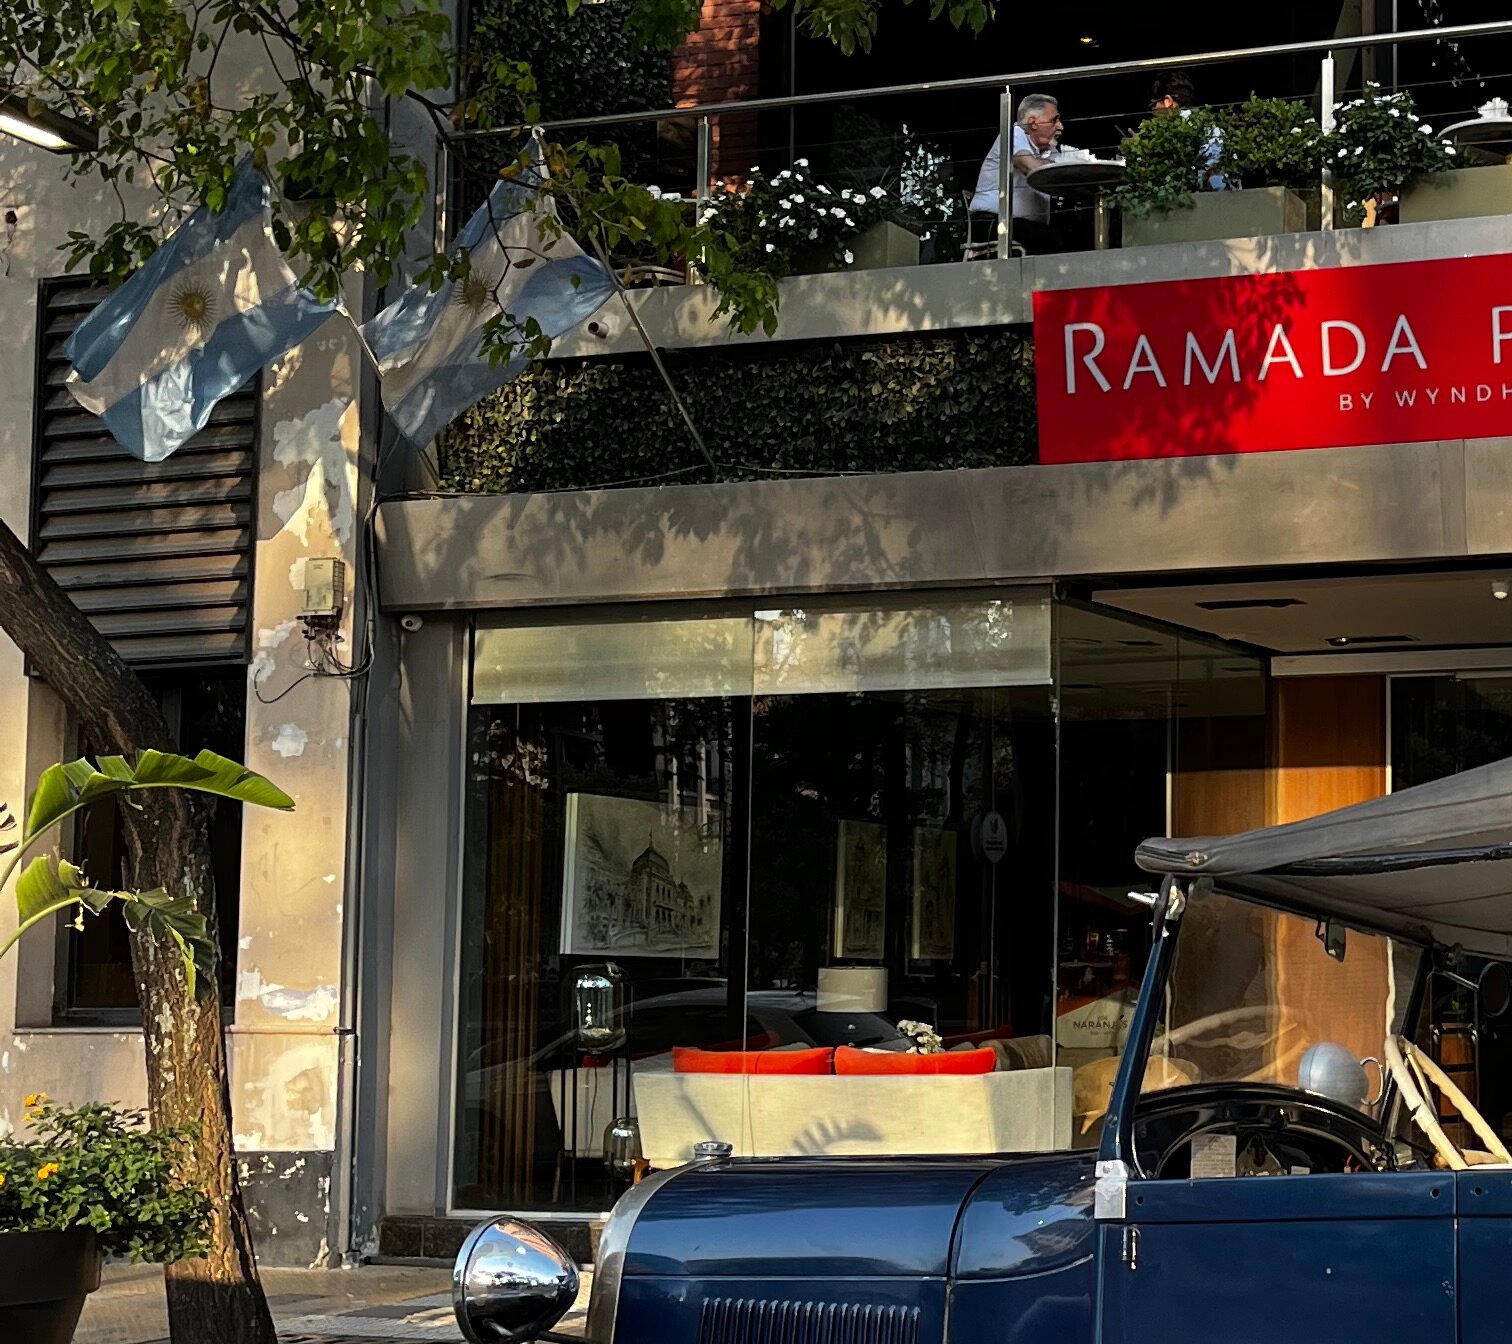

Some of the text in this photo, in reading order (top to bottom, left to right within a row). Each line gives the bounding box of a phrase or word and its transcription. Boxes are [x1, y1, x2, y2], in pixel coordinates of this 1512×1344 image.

[1064, 314, 1428, 395] RAMADA
[1339, 392, 1374, 411] BY
[1073, 1020, 1127, 1029] NARANJS
